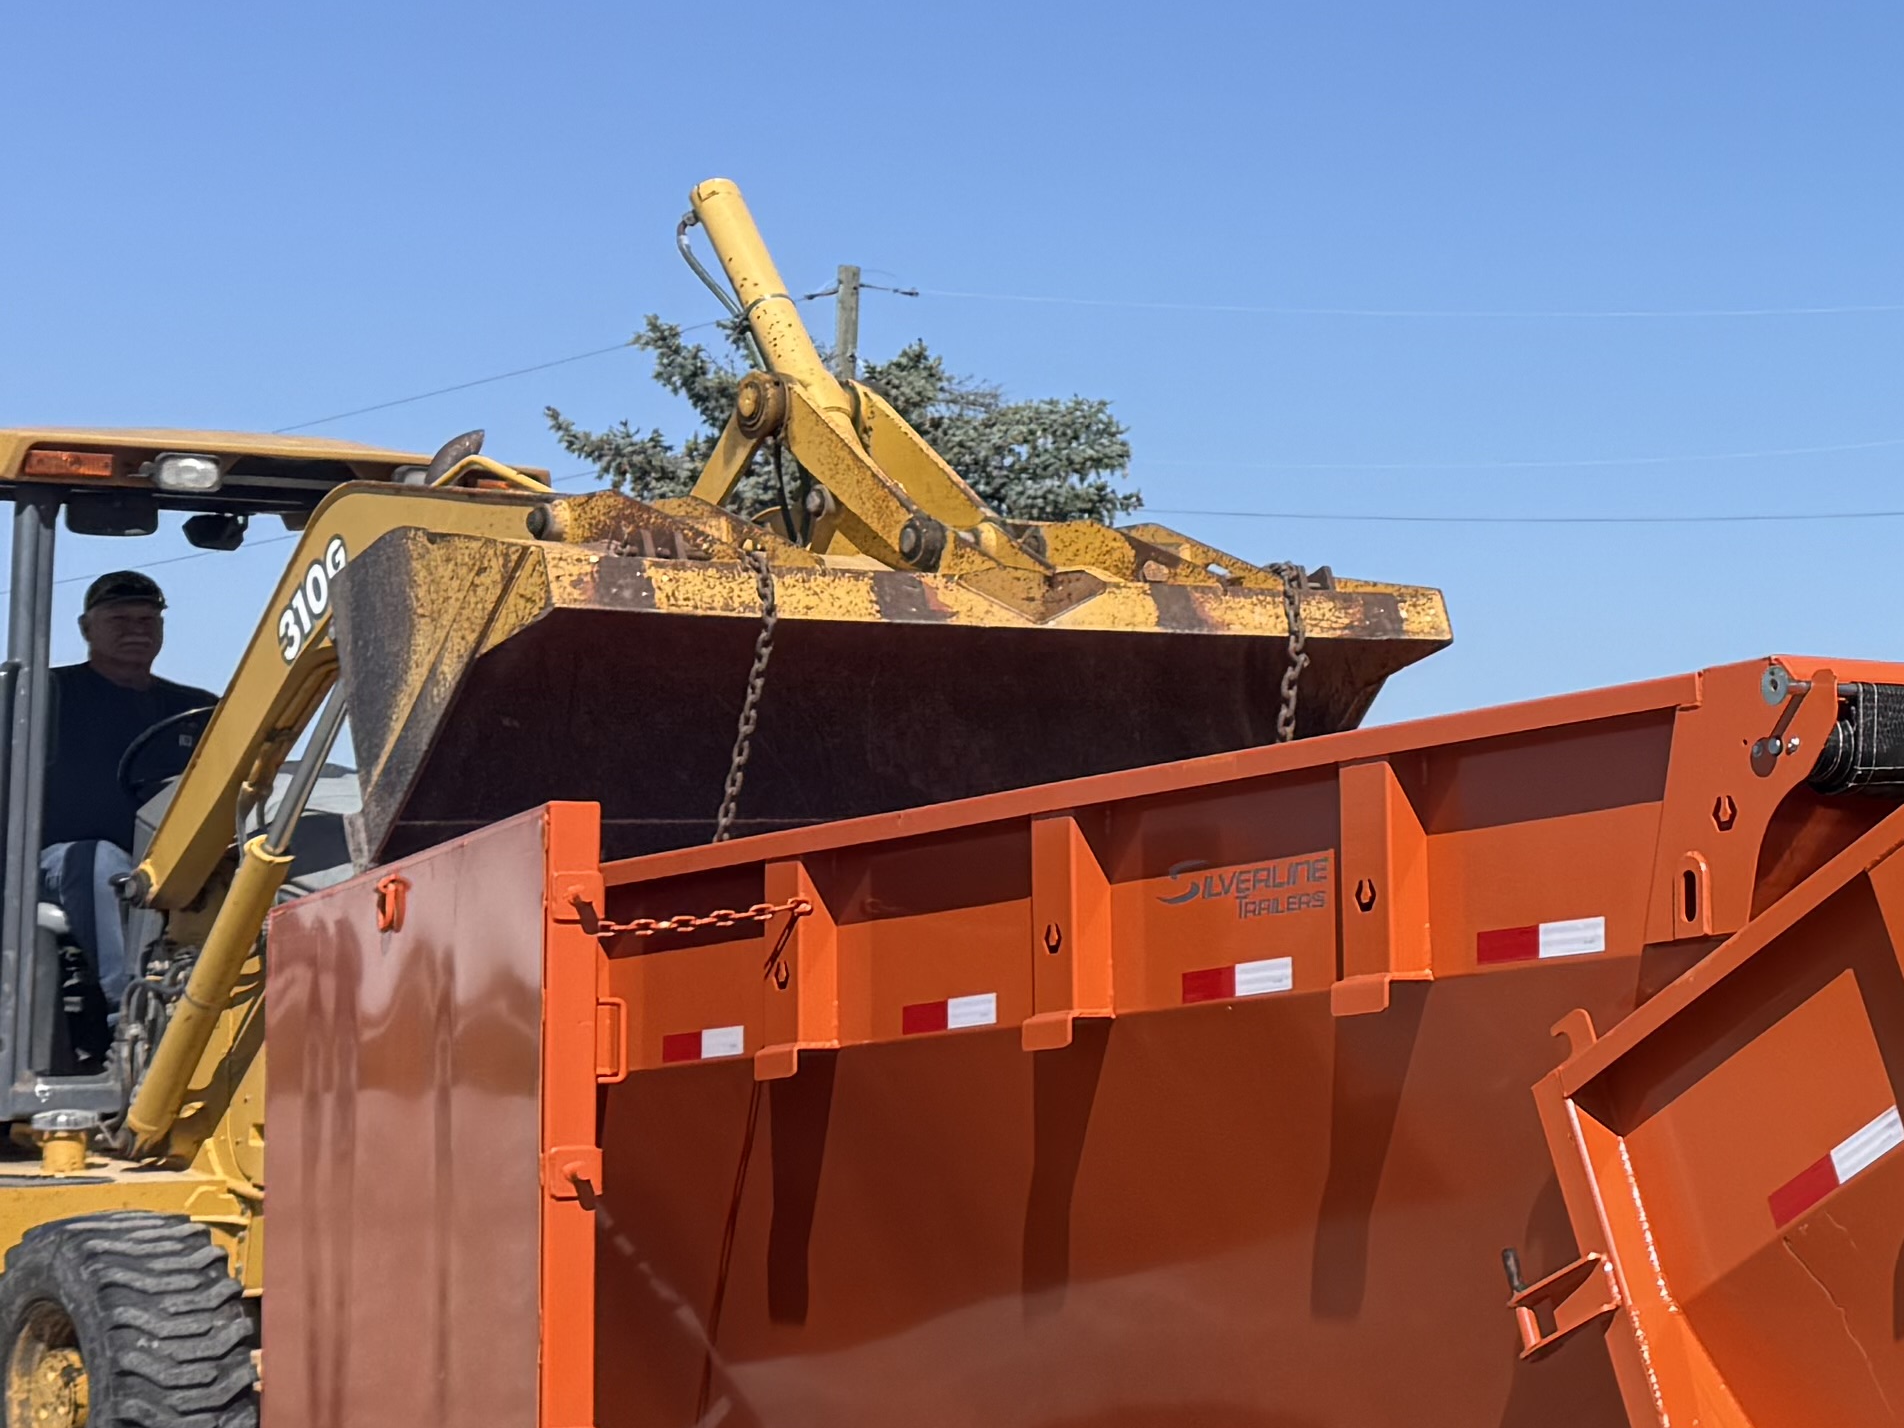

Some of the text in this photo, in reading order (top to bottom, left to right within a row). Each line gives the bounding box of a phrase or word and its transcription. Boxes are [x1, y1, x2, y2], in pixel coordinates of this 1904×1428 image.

[278, 536, 347, 662] 310G
[1157, 858, 1329, 904] SILVERLINE
[1236, 891, 1326, 919] TRAILERS
